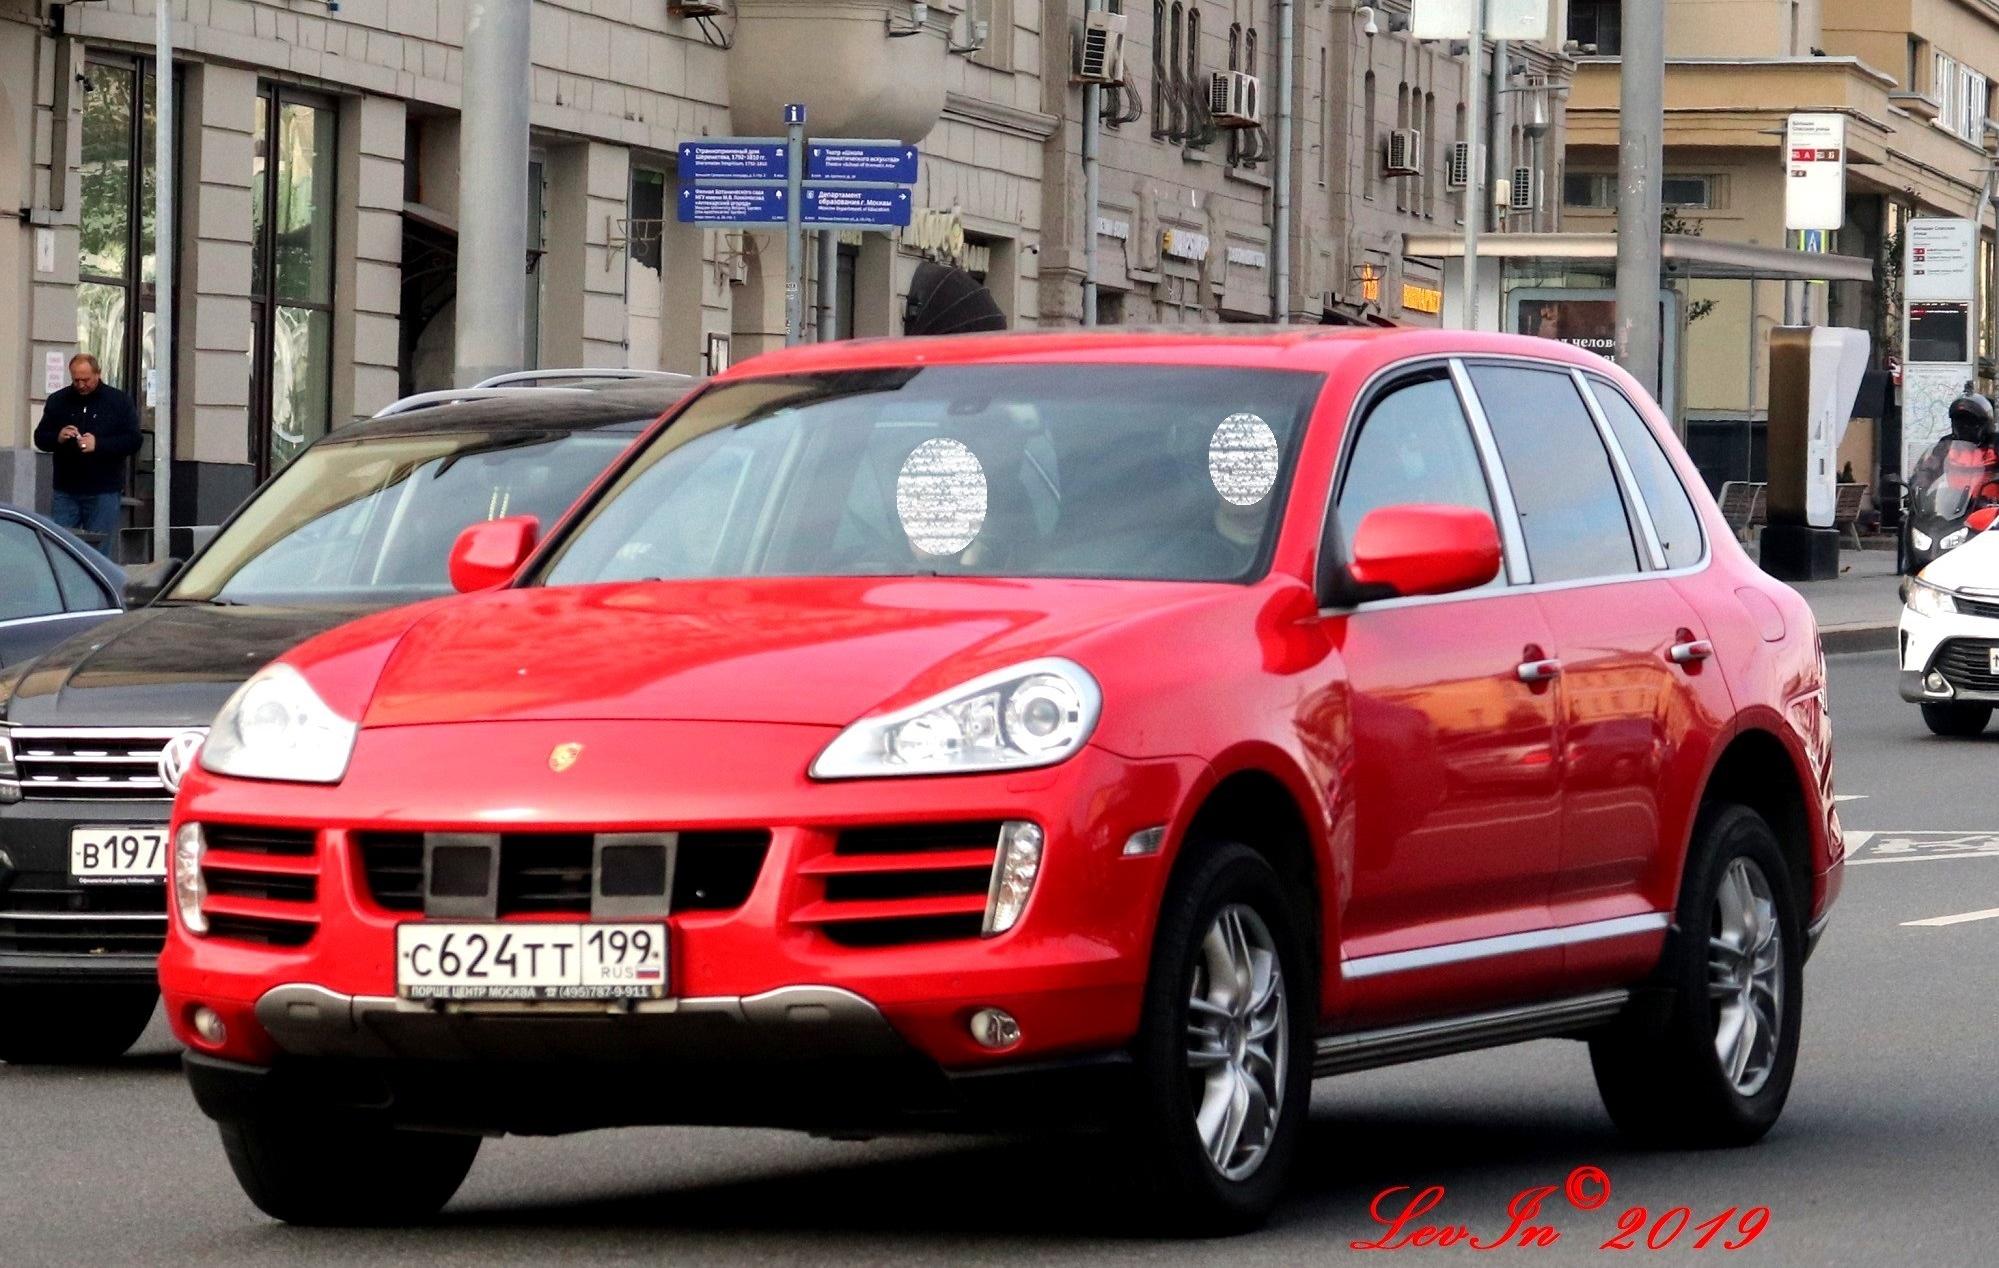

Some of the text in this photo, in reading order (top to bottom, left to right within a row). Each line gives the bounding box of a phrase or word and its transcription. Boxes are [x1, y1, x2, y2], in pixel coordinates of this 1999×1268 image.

[818, 191, 862, 199] Департамент
[588, 929, 652, 964] 199
[600, 966, 634, 979] RUS
[411, 985, 449, 998] ПОРШЕ
[451, 985, 488, 998] ЦЕНТР
[488, 985, 536, 998] МОСКВА
